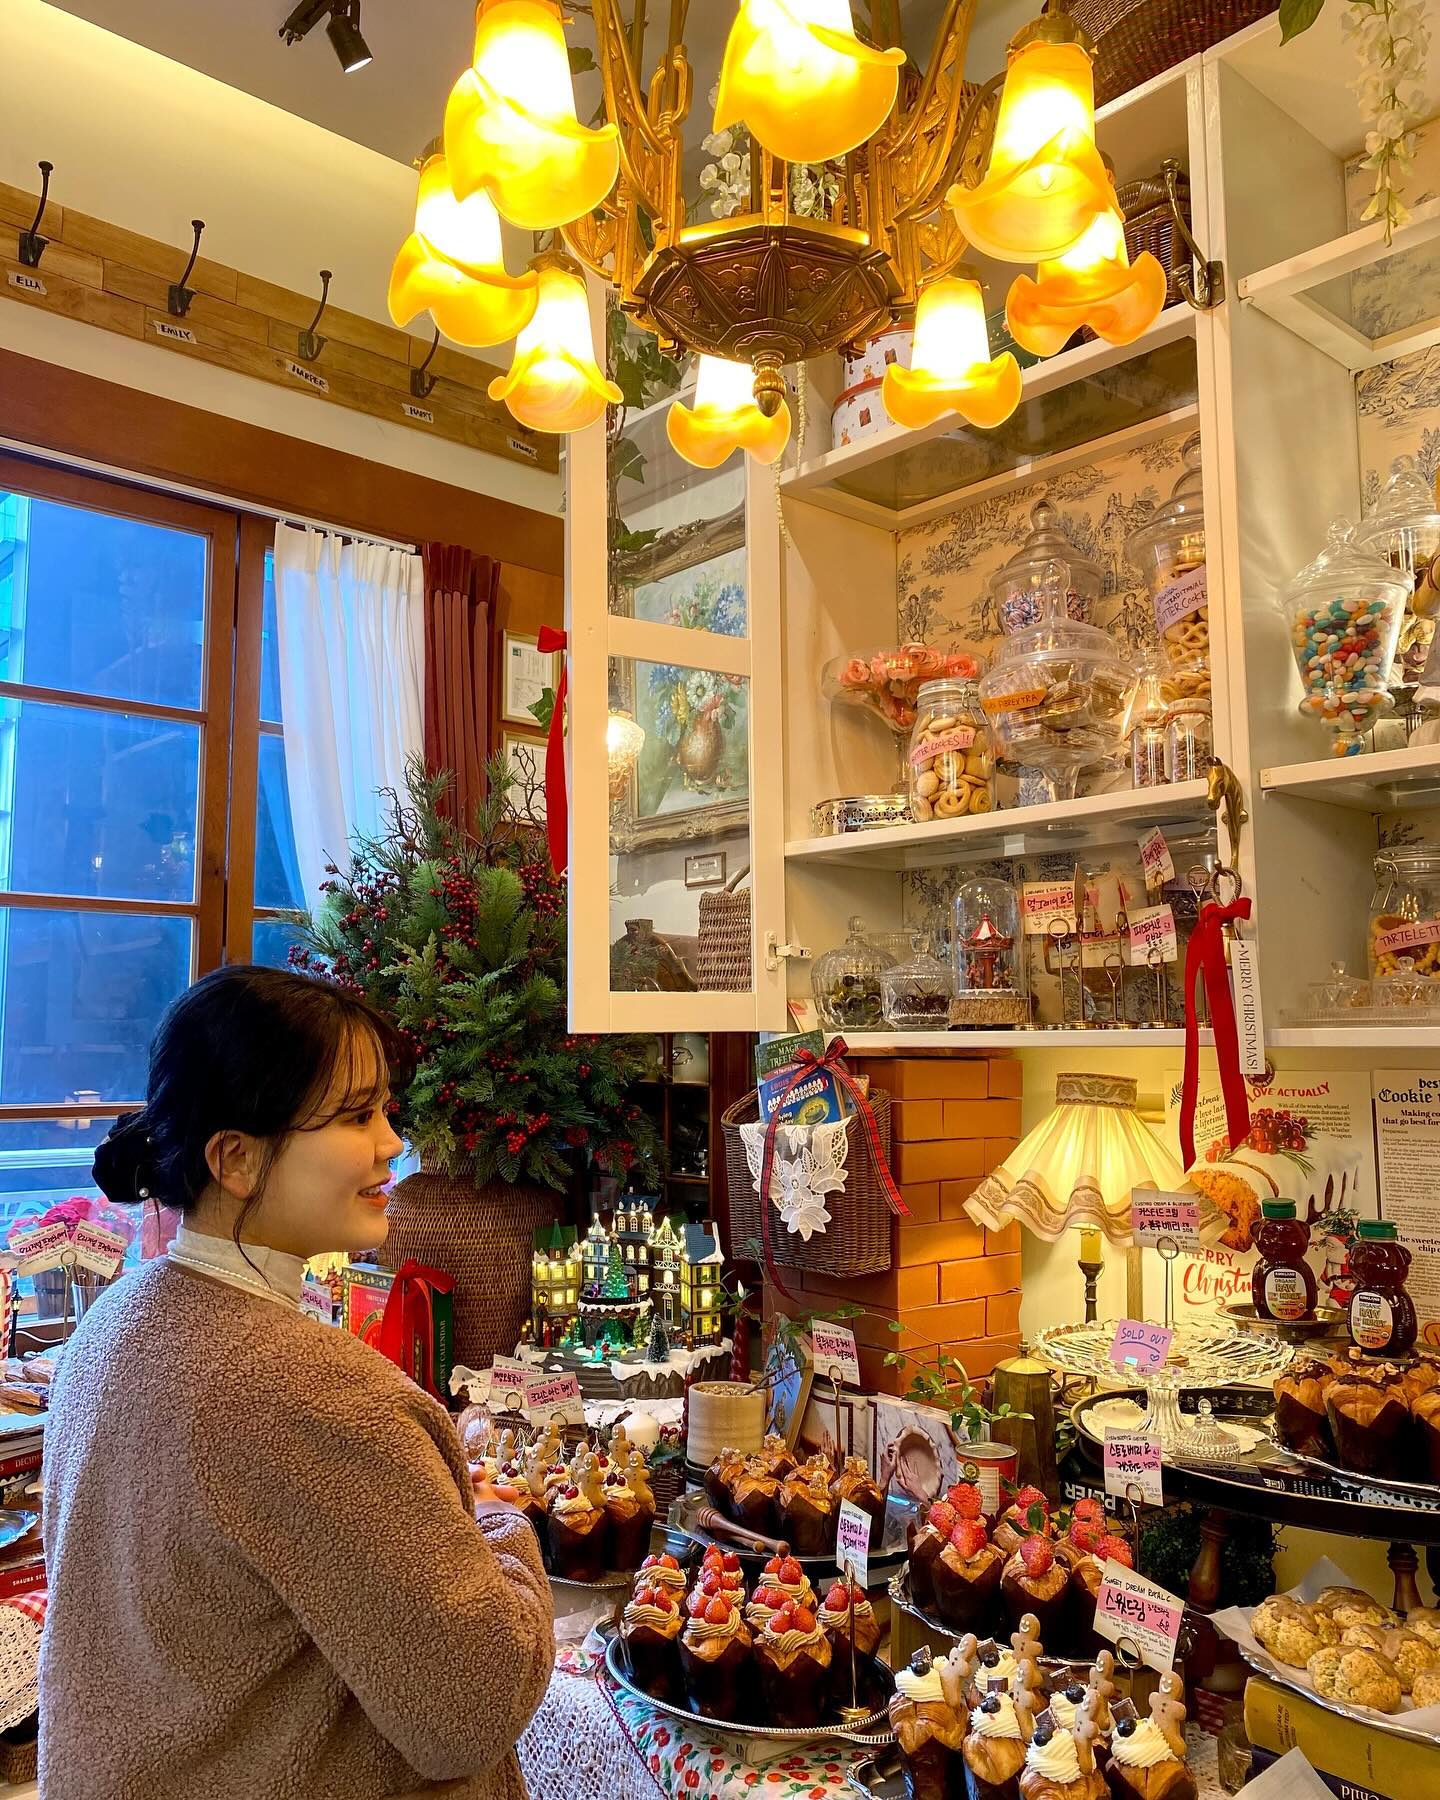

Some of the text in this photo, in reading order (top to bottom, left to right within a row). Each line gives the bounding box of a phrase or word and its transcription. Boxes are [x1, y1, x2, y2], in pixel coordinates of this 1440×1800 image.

[16, 275, 41, 290] ELLA
[160, 324, 192, 340] EMILY
[291, 364, 326, 388] HARPER
[1238, 950, 1258, 1070] MERRY CHRISTMAS!
[778, 1043, 800, 1056] MAGIC
[770, 1055, 788, 1069] TREE
[1248, 1082, 1331, 1103] LOVE ACTUALLY
[1379, 1088, 1433, 1103] Cookie
[1400, 1109, 1431, 1118] Making
[1382, 1117, 1398, 1125] that
[1410, 1117, 1426, 1126] best
[1418, 1245, 1436, 1254] chip
[1275, 1284, 1297, 1293] RAW
[1360, 1309, 1381, 1319] RAW
[439, 1320, 447, 1362] CALENDAR
[1121, 1327, 1167, 1345] SOLD OUT
[561, 1380, 575, 1394] BOY
[1104, 1576, 1122, 1588] SWEET
[1125, 1583, 1147, 1597] DREAM
[1148, 1588, 1166, 1602] ROYAL
[1106, 1589, 1146, 1622] 스윗드림
